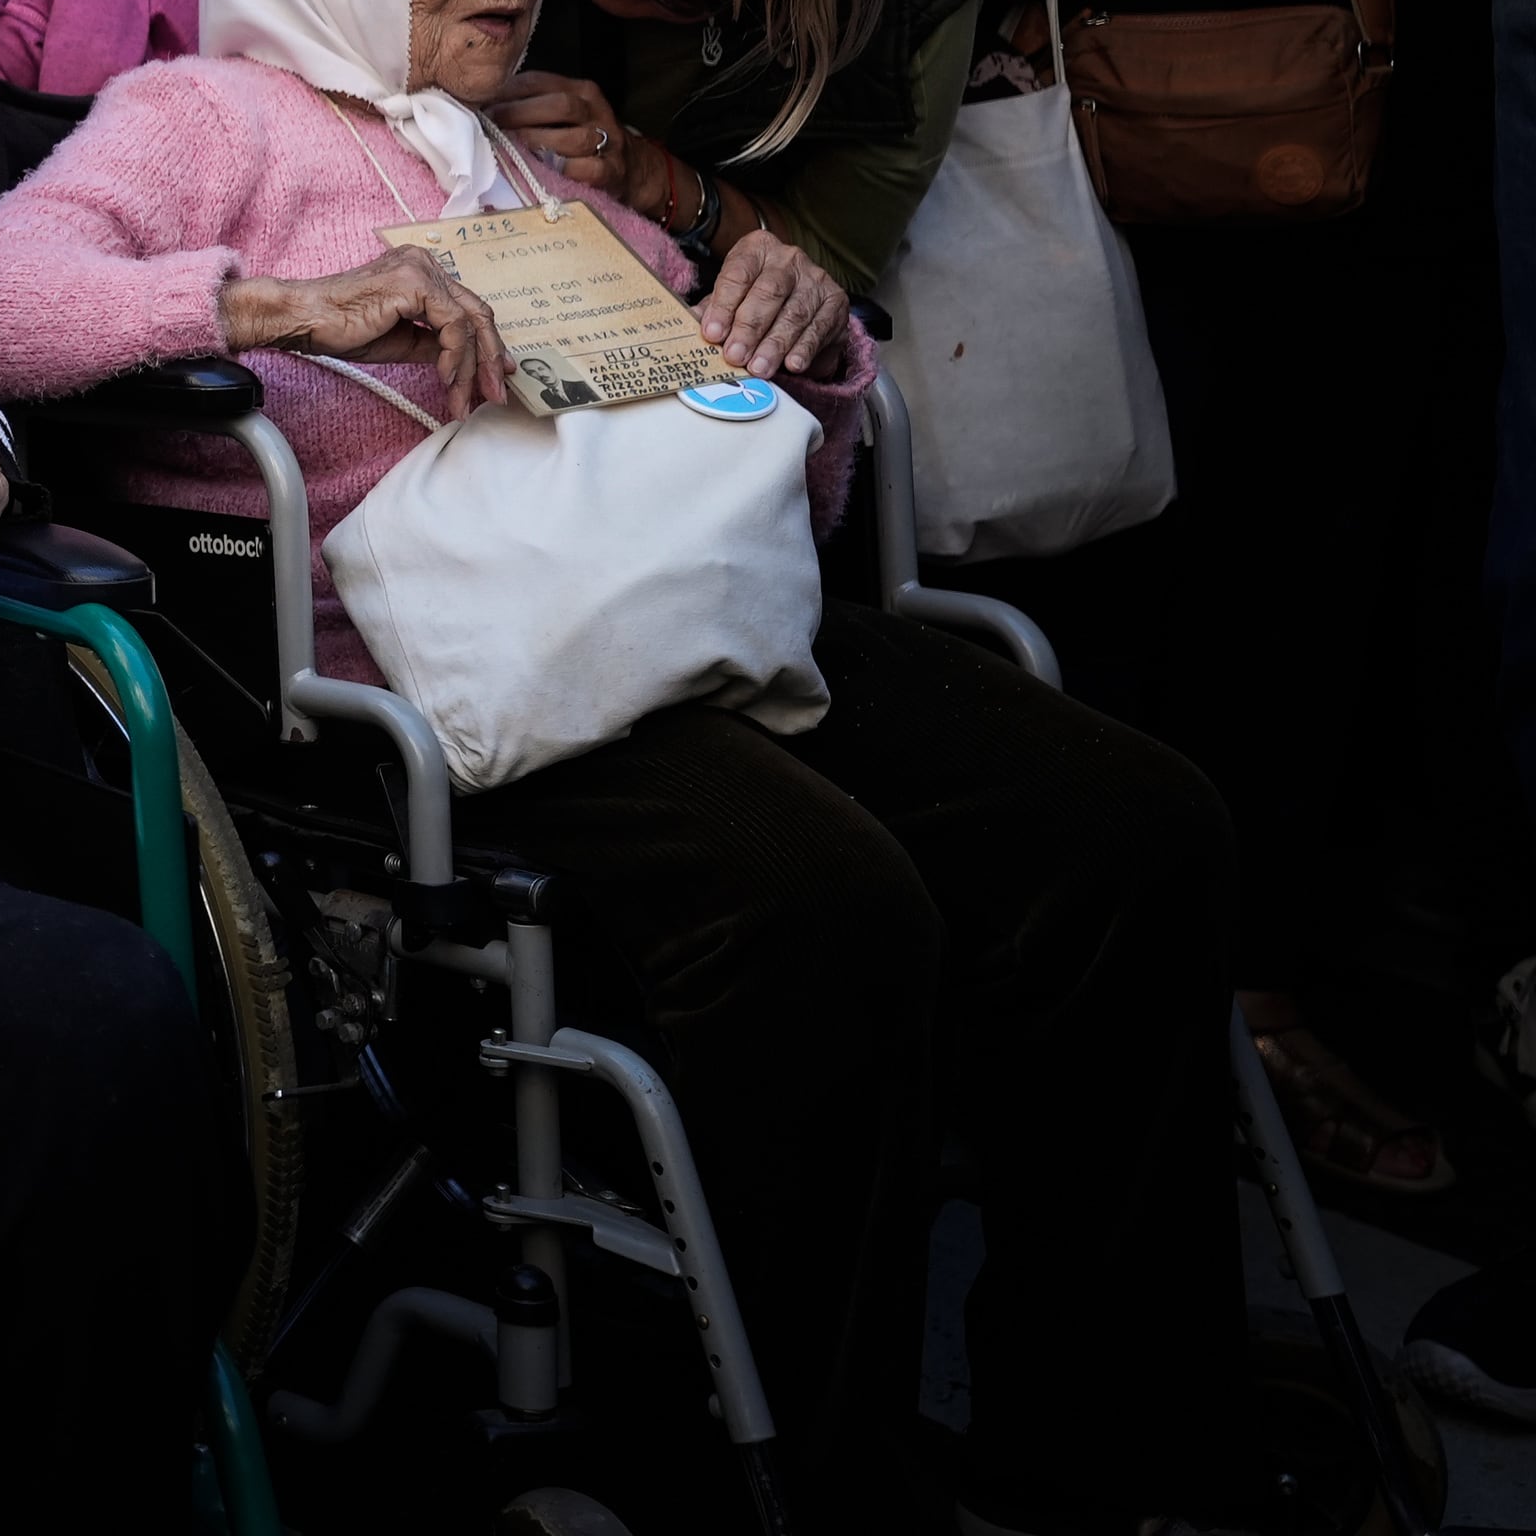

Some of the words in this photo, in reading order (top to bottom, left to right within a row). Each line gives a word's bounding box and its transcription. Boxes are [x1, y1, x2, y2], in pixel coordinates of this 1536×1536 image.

[551, 278, 581, 292] con
[588, 270, 624, 284] vida
[531, 298, 550, 310] de
[560, 293, 583, 305] los
[557, 337, 572, 347] DE
[578, 330, 618, 343] PLAZA
[624, 325, 639, 335] DE
[644, 317, 684, 333] MAYO
[604, 346, 650, 364] HIJO
[590, 360, 639, 374] NACIDO
[593, 369, 645, 384] CARLOS
[649, 358, 709, 376] ALBERTO
[599, 379, 643, 393] RIZZO
[648, 370, 704, 384] MOLINA
